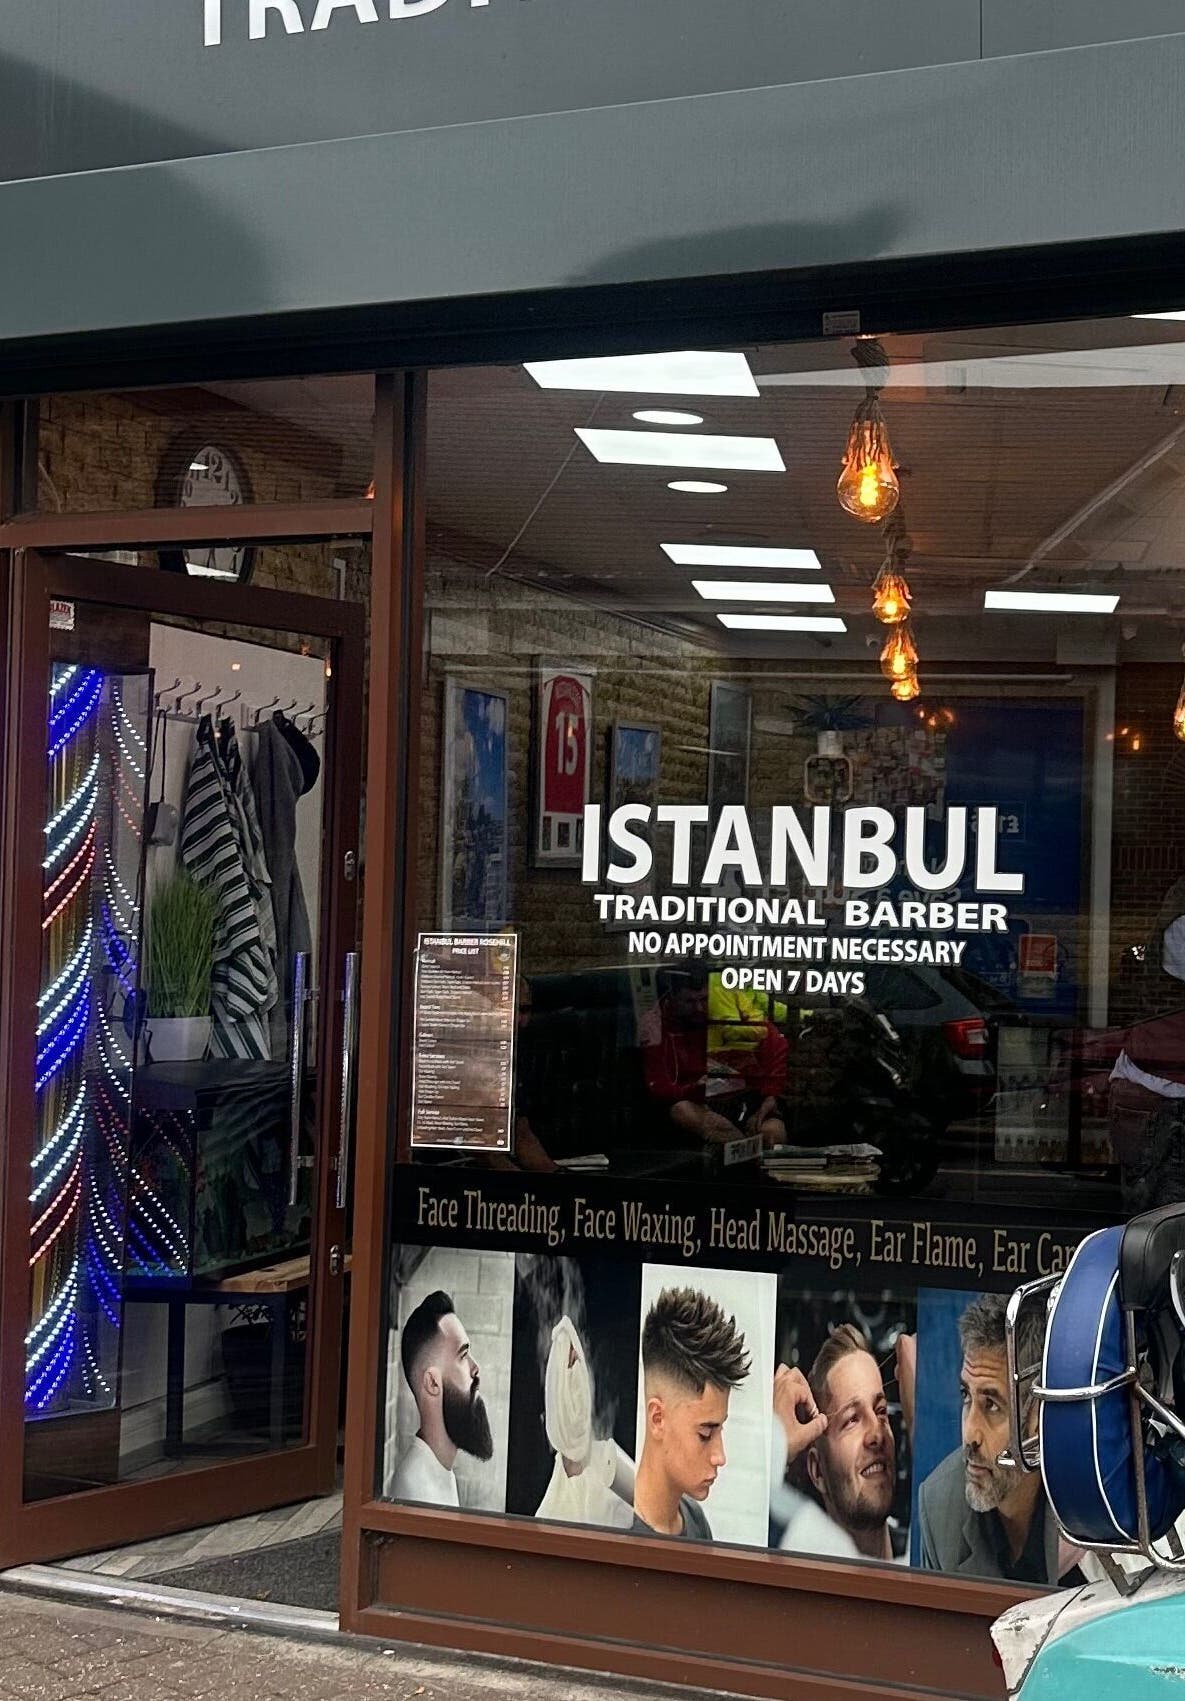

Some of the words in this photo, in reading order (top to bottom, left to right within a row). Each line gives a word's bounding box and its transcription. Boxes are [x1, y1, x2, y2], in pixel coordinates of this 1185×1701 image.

[555, 712, 579, 776] 15
[582, 803, 1024, 892] ISTANBUL
[594, 893, 827, 927] TRADITIONAL
[843, 899, 1008, 932] BARBER
[628, 930, 663, 955] NO
[664, 931, 829, 960] APPOINTMENT
[831, 936, 967, 965] NECESSARY
[720, 966, 783, 992] OPEN
[787, 969, 801, 993] 7
[805, 970, 866, 997] DAYS
[417, 1187, 458, 1228] Face
[463, 1189, 566, 1246] Threading,
[573, 1198, 616, 1240] Face
[622, 1201, 701, 1258] Waxing,
[709, 1207, 761, 1251] Head
[767, 1211, 862, 1269] Massage,
[869, 1219, 906, 1263] Ear
[911, 1222, 983, 1278] Flame,
[992, 1229, 1031, 1274] Ear
